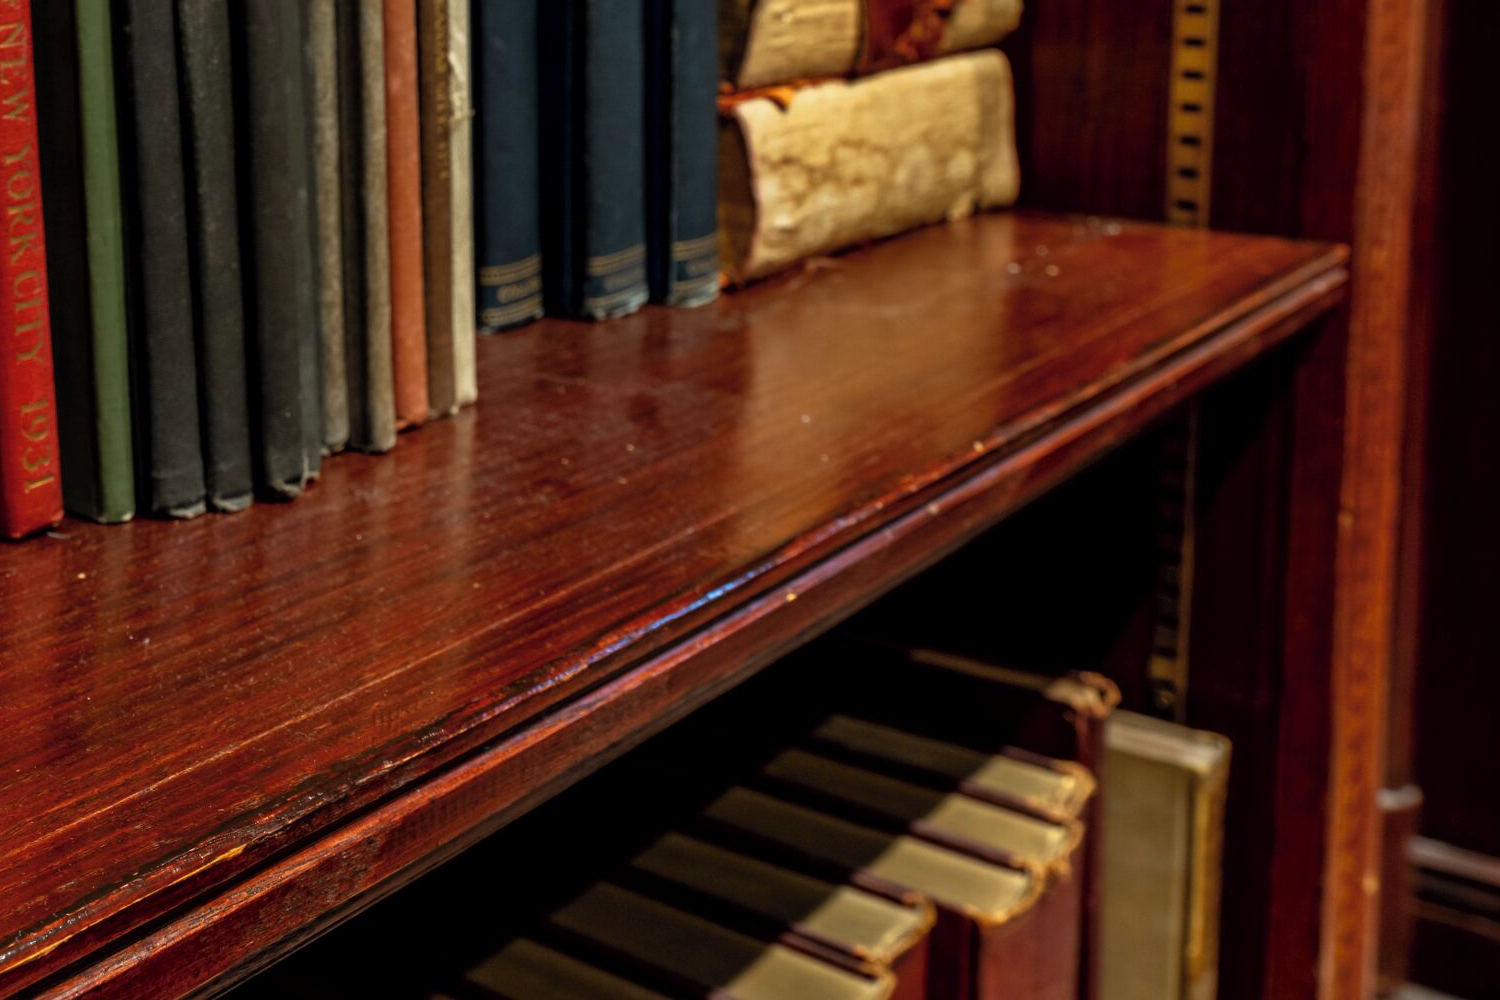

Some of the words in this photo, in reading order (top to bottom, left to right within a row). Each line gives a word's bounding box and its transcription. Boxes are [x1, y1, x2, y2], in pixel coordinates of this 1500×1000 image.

[2, 142, 40, 263] YORK
[12, 269, 46, 366] CITY
[19, 399, 56, 495] 1931
